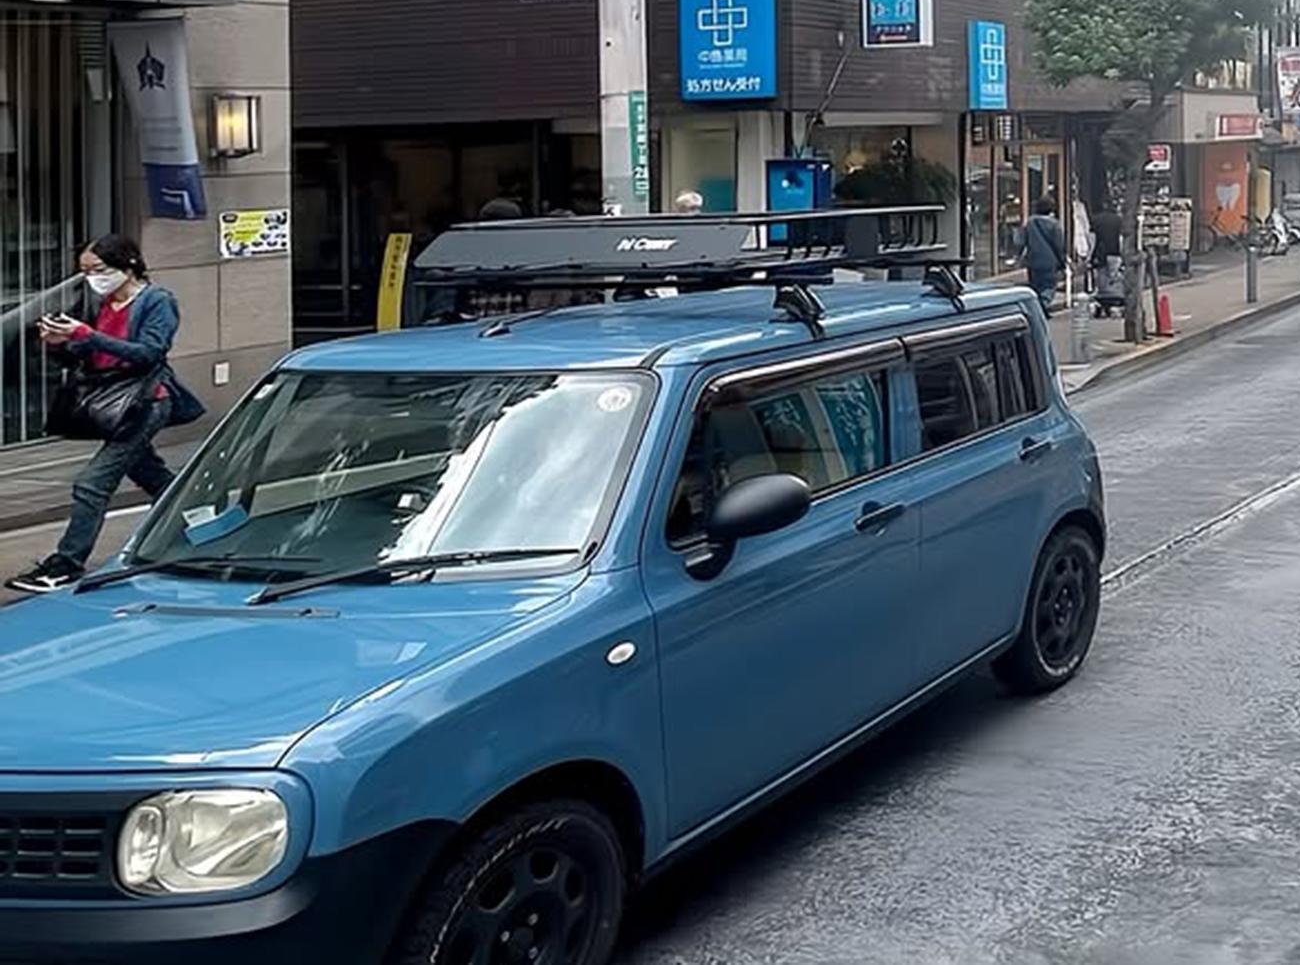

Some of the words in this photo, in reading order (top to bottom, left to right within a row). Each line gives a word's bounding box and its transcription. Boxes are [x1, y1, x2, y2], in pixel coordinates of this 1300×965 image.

[686, 77, 761, 95] 処方せん受付
